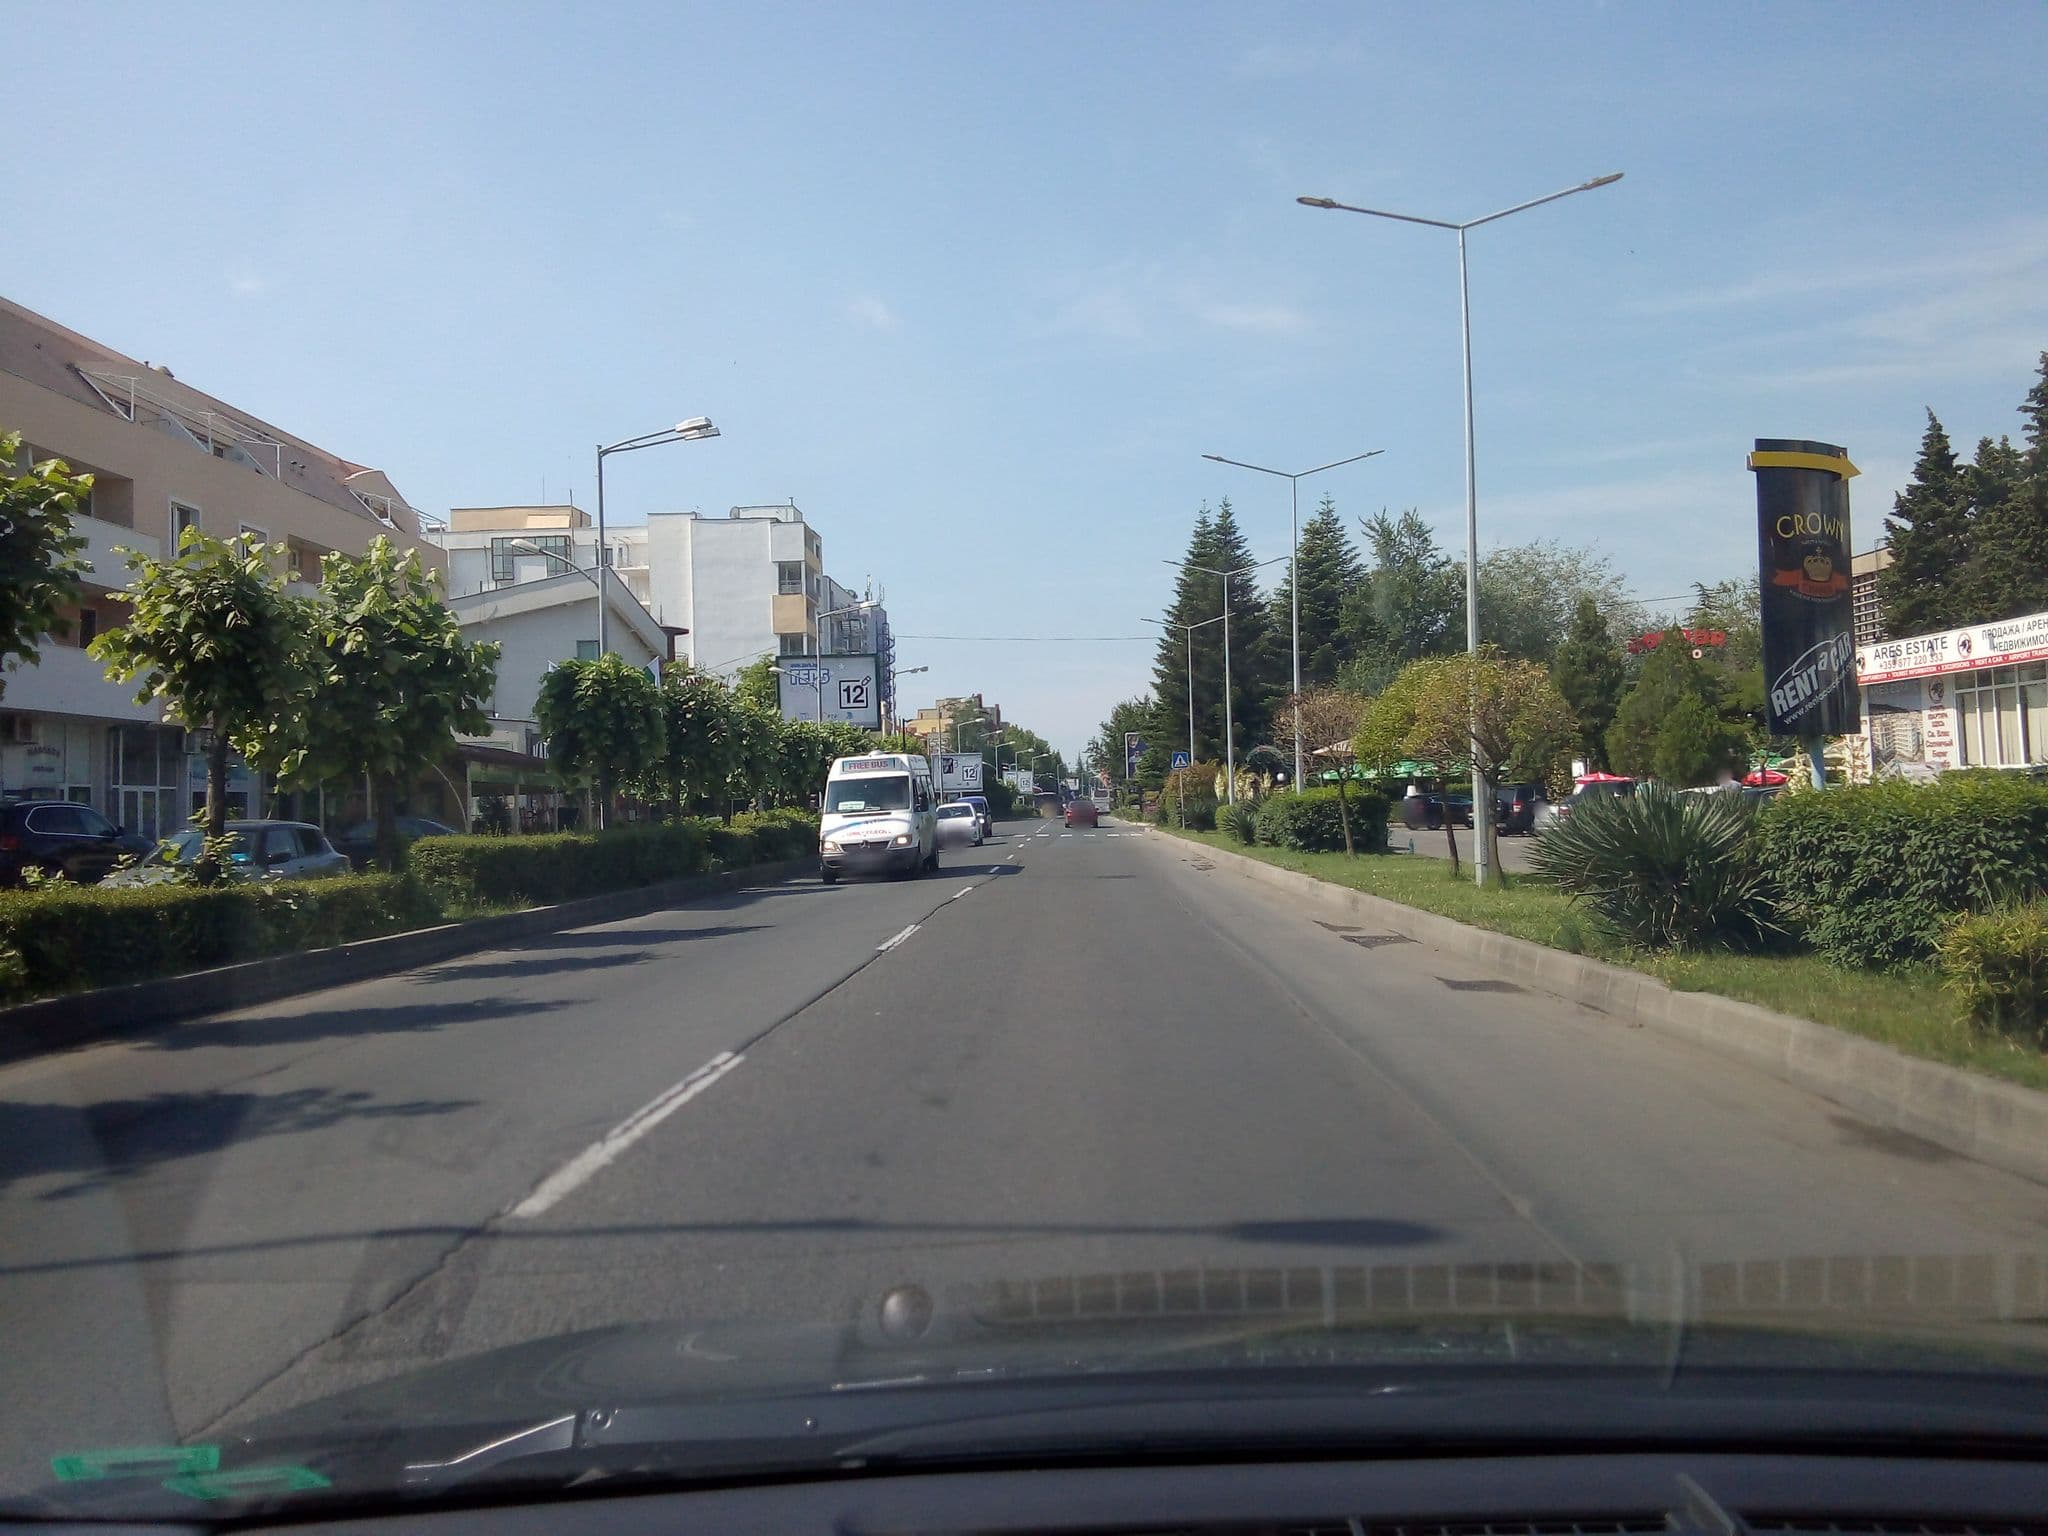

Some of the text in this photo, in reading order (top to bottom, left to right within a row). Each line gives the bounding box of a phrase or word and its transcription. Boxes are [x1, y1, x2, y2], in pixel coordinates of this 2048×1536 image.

[1776, 512, 1844, 542] CROWN
[1982, 624, 2020, 640] ПРОДАЖА
[1874, 636, 1948, 660] ARES ESTATE
[1914, 654, 1927, 666] 220
[1929, 652, 1944, 664] 333
[1771, 633, 1852, 718] RENT a CAR
[842, 685, 865, 704] 12
[849, 760, 889, 770] FREE BUS
[964, 769, 976, 778] 12
